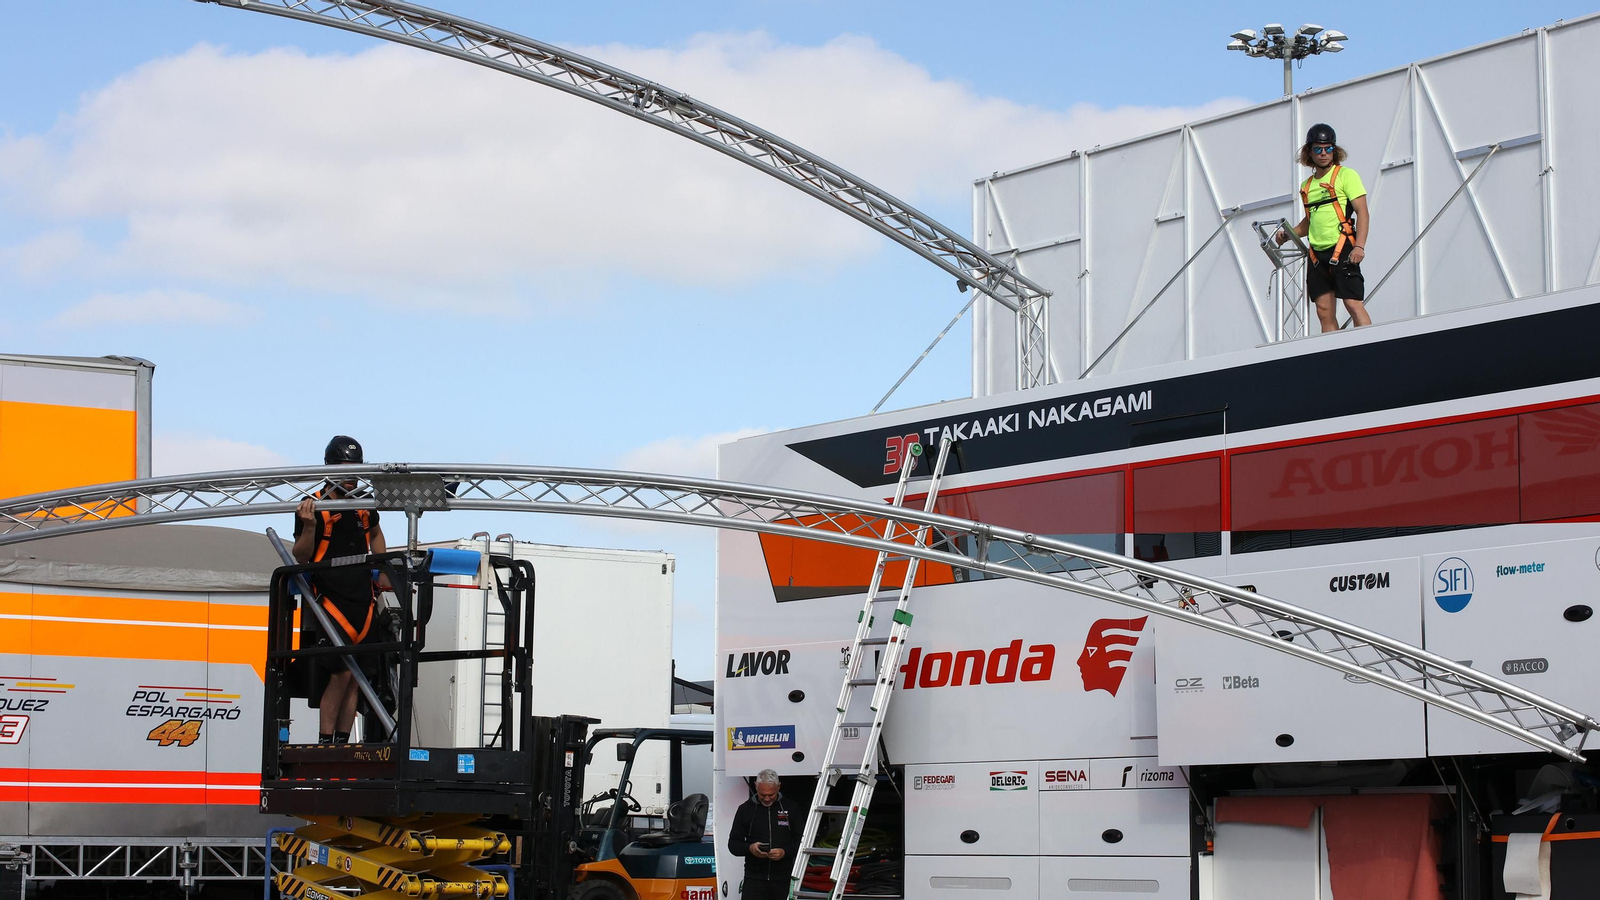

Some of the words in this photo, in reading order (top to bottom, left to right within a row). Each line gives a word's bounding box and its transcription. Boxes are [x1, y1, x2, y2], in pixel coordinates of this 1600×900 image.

[924, 412, 1019, 445] TAKAAKI
[1029, 390, 1152, 430] NAKAGAMI
[1496, 562, 1545, 577] flow-meter
[1329, 572, 1390, 593] CUSTOM
[1437, 568, 1467, 593] SIFI
[726, 650, 791, 678] LAVOR
[1513, 661, 1545, 673] BACCO
[1233, 676, 1259, 689] Beta
[132, 691, 170, 703] POL
[126, 705, 241, 720] ESPARGARÓ
[146, 719, 204, 747] 44
[746, 733, 790, 743] MICHELIN
[923, 775, 955, 784] FEDEGARI
[1045, 770, 1087, 782] SENA
[1140, 769, 1174, 782] rizoma
[563, 769, 572, 807] TOYOTA
